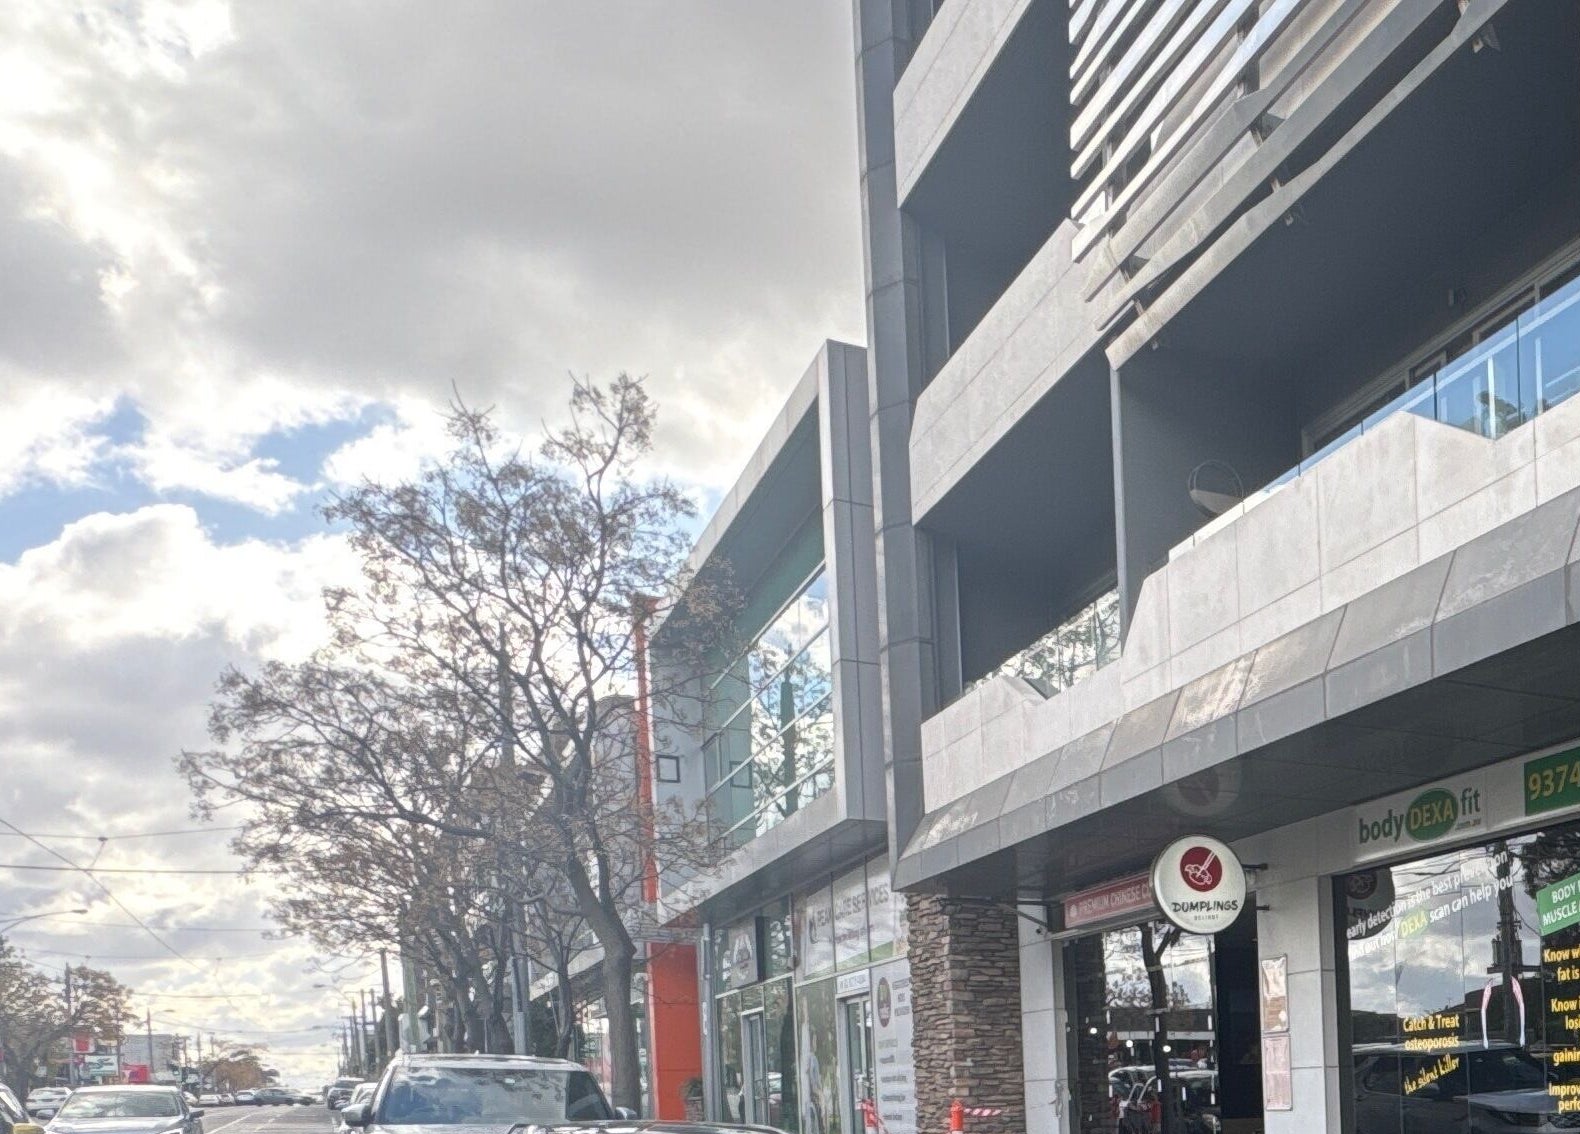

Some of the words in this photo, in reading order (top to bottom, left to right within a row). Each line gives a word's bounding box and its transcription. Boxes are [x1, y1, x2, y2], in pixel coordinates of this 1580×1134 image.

[1359, 808, 1404, 844] body
[1409, 799, 1457, 831] DEXA
[1460, 787, 1481, 816] fit
[1429, 906, 1450, 923] scan
[1451, 895, 1469, 912] can
[1470, 882, 1492, 906] help
[1494, 875, 1514, 898] you
[1551, 882, 1578, 903] BODY
[1171, 900, 1239, 913] DUMPLINGS
[1542, 902, 1577, 926] MUSCLE
[1347, 918, 1366, 939] early
[1543, 946, 1570, 963] Know
[1557, 966, 1571, 982] fat
[1572, 965, 1579, 980] is
[1551, 998, 1577, 1012] Know
[1403, 1015, 1427, 1032] Catch
[1428, 1015, 1435, 1030] &
[1435, 1013, 1460, 1029] Treat
[1404, 1032, 1459, 1053] osteoporosis
[1437, 1053, 1460, 1075] killer
